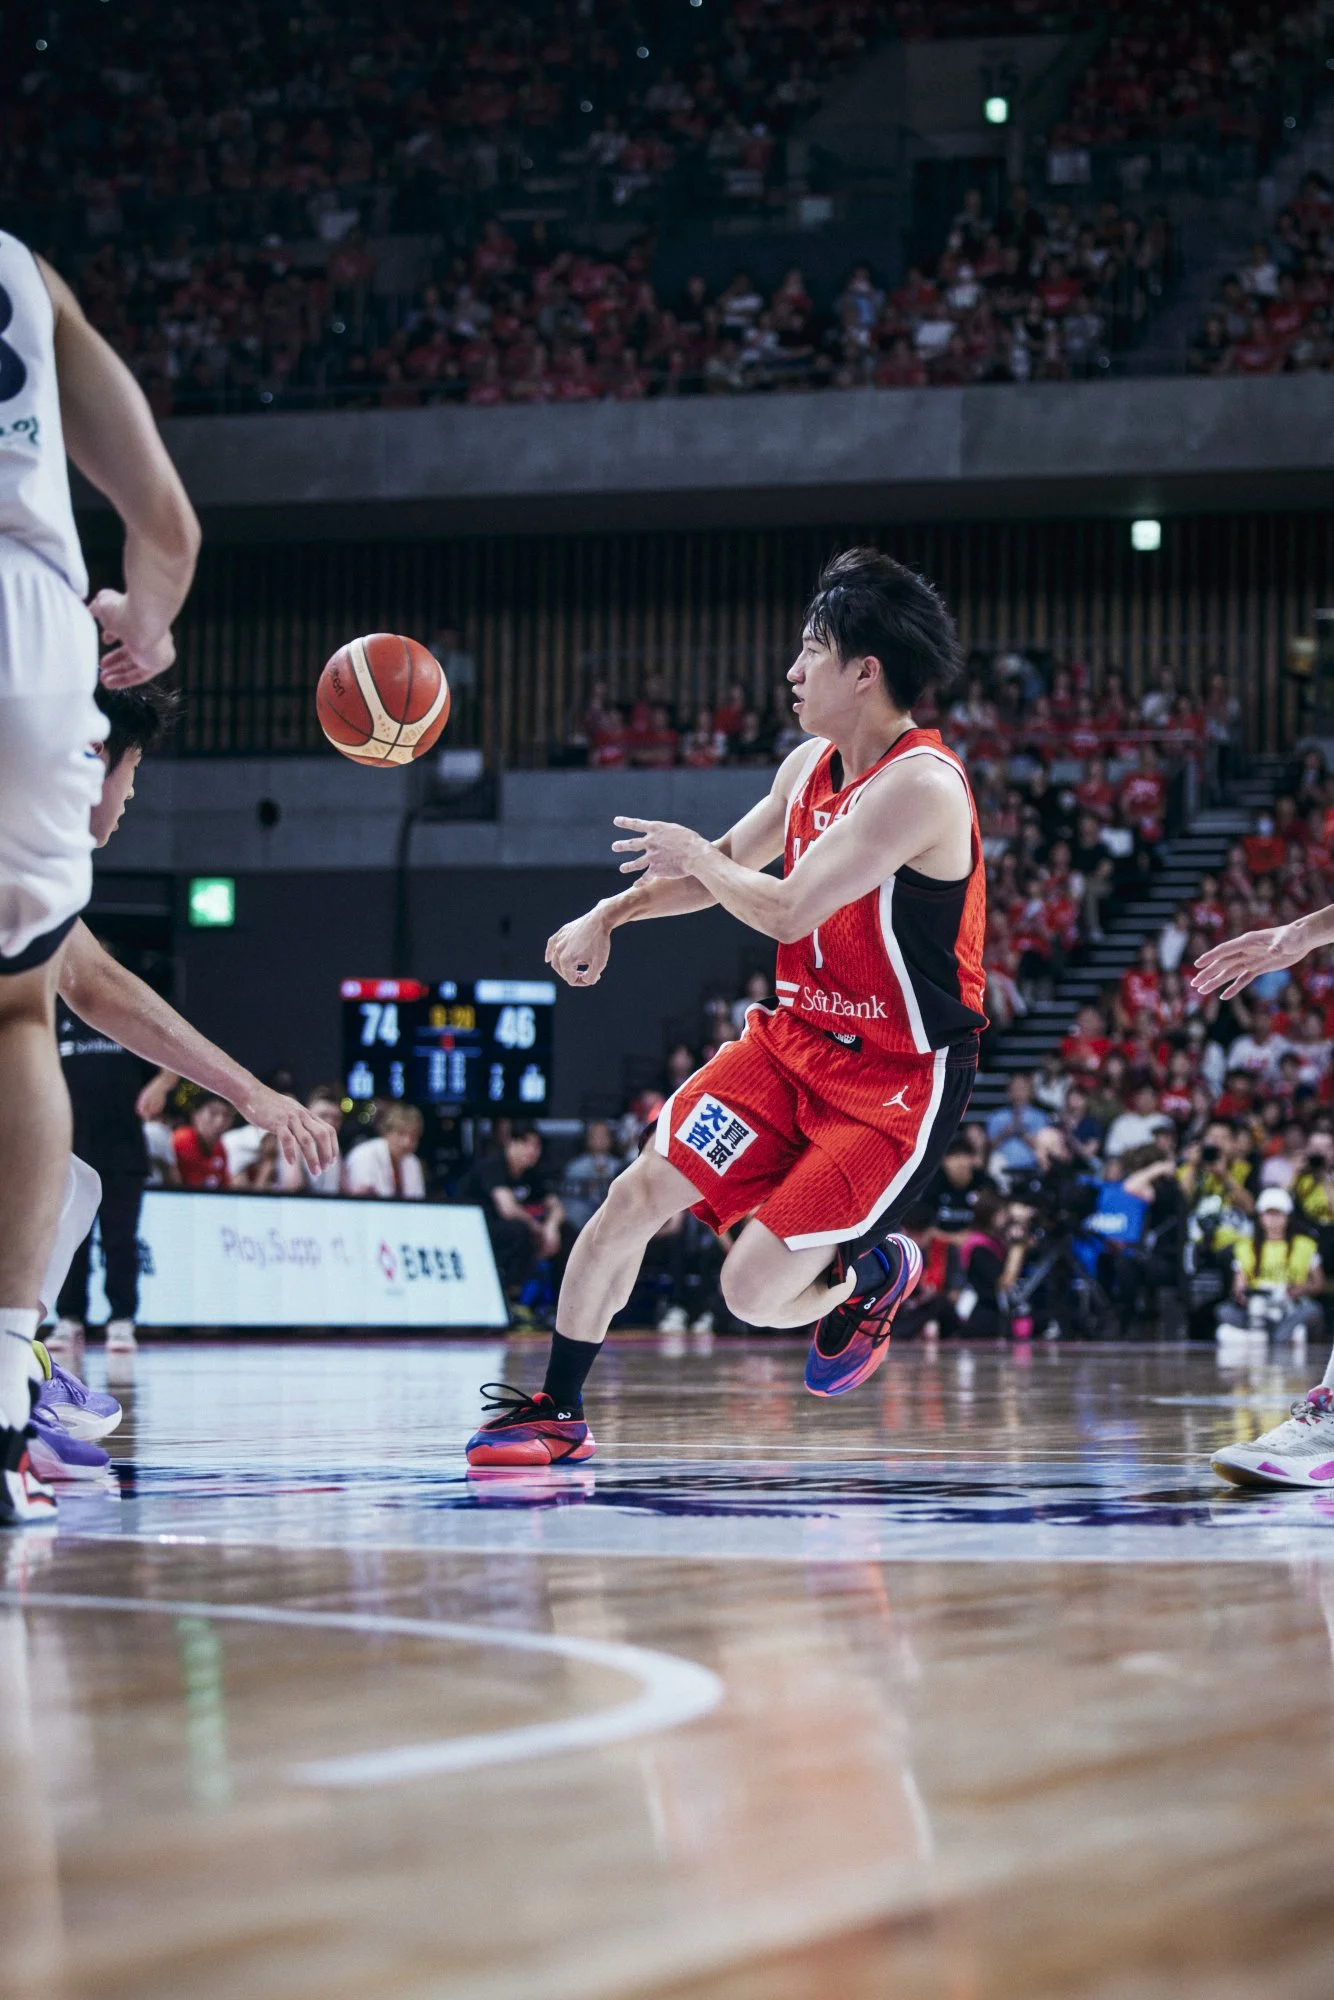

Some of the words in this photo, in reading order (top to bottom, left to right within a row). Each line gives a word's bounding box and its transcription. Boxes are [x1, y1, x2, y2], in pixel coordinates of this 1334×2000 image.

[358, 1002, 401, 1047] 74
[801, 986, 888, 1019] SoftBank
[494, 1005, 537, 1050] 46
[686, 1103, 728, 1151] 大吉
